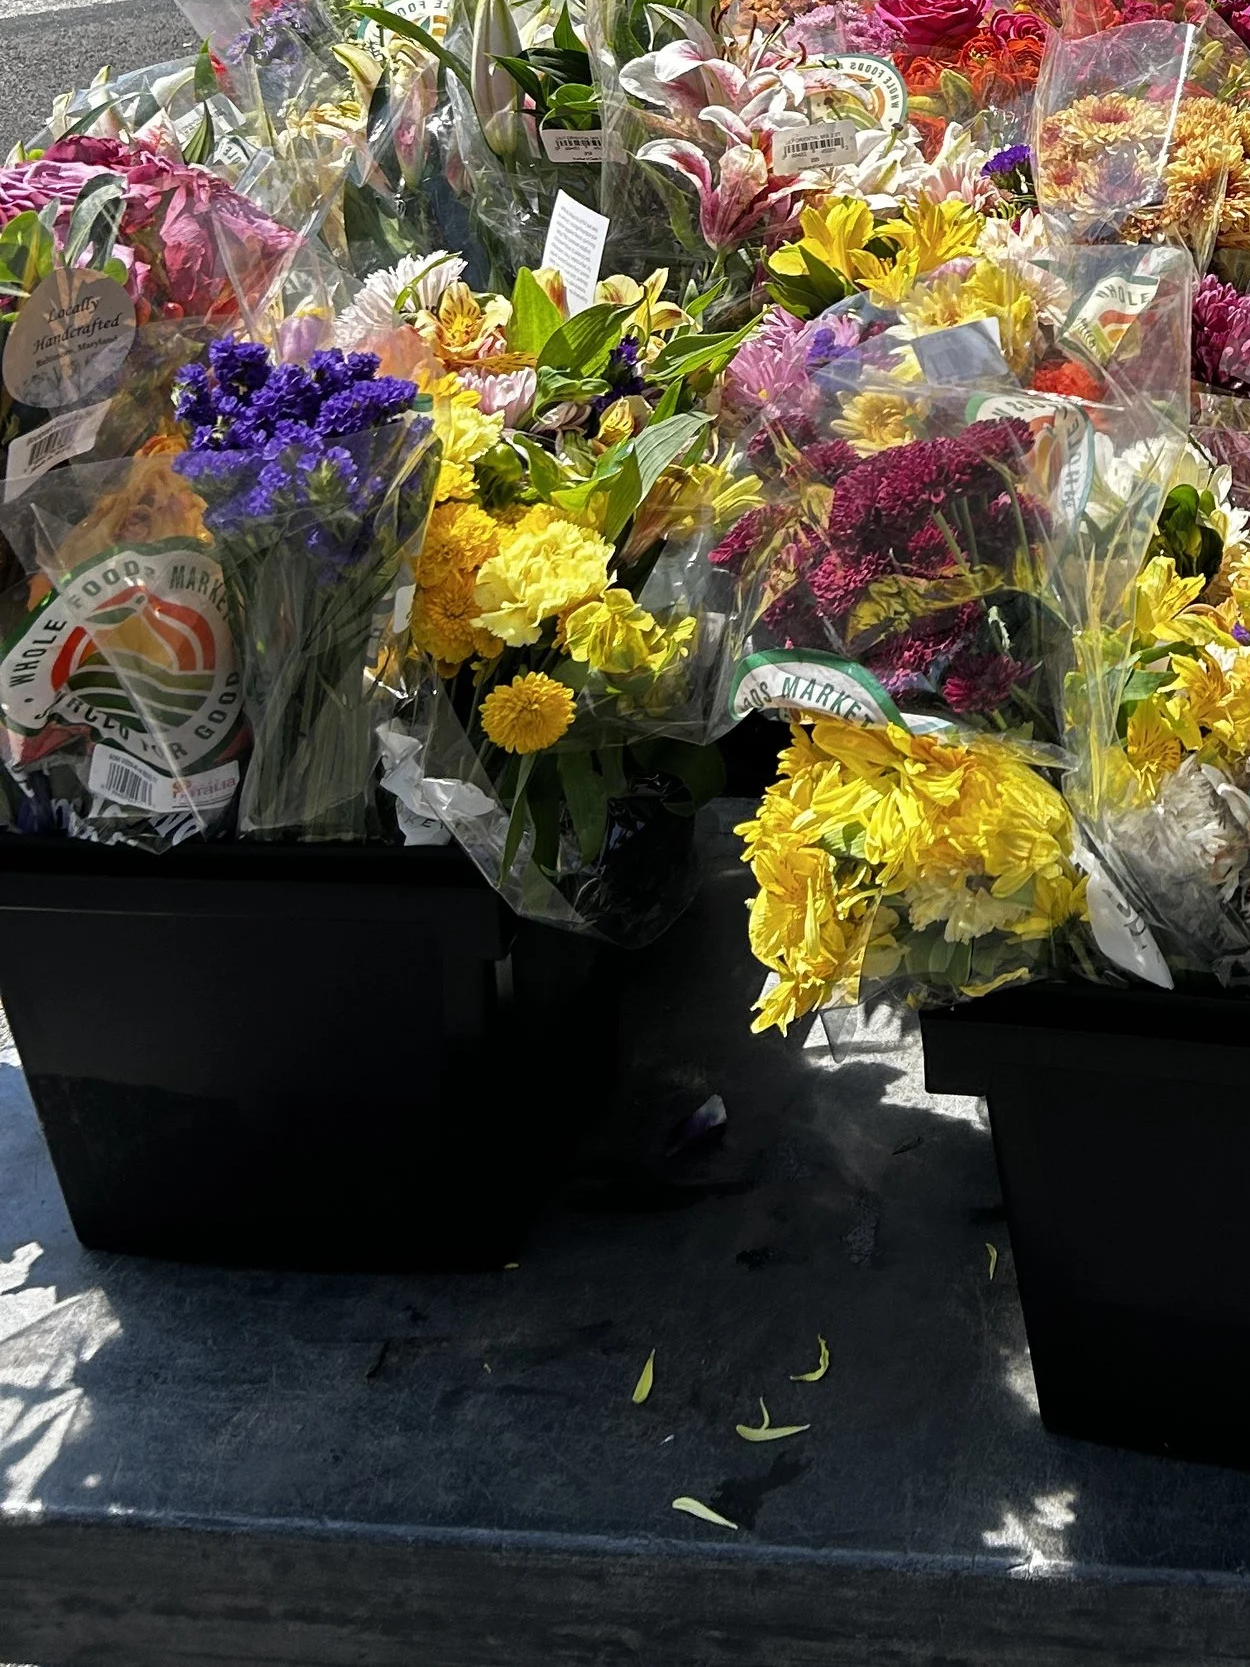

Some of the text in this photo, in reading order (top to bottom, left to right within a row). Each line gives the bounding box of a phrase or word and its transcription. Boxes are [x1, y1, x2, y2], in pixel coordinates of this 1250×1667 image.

[33, 312, 122, 354] Handcrafted
[48, 296, 100, 323] Locally
[10, 619, 67, 687] WHOLE
[194, 672, 240, 740] GOOD
[782, 677, 875, 727] MARKET
